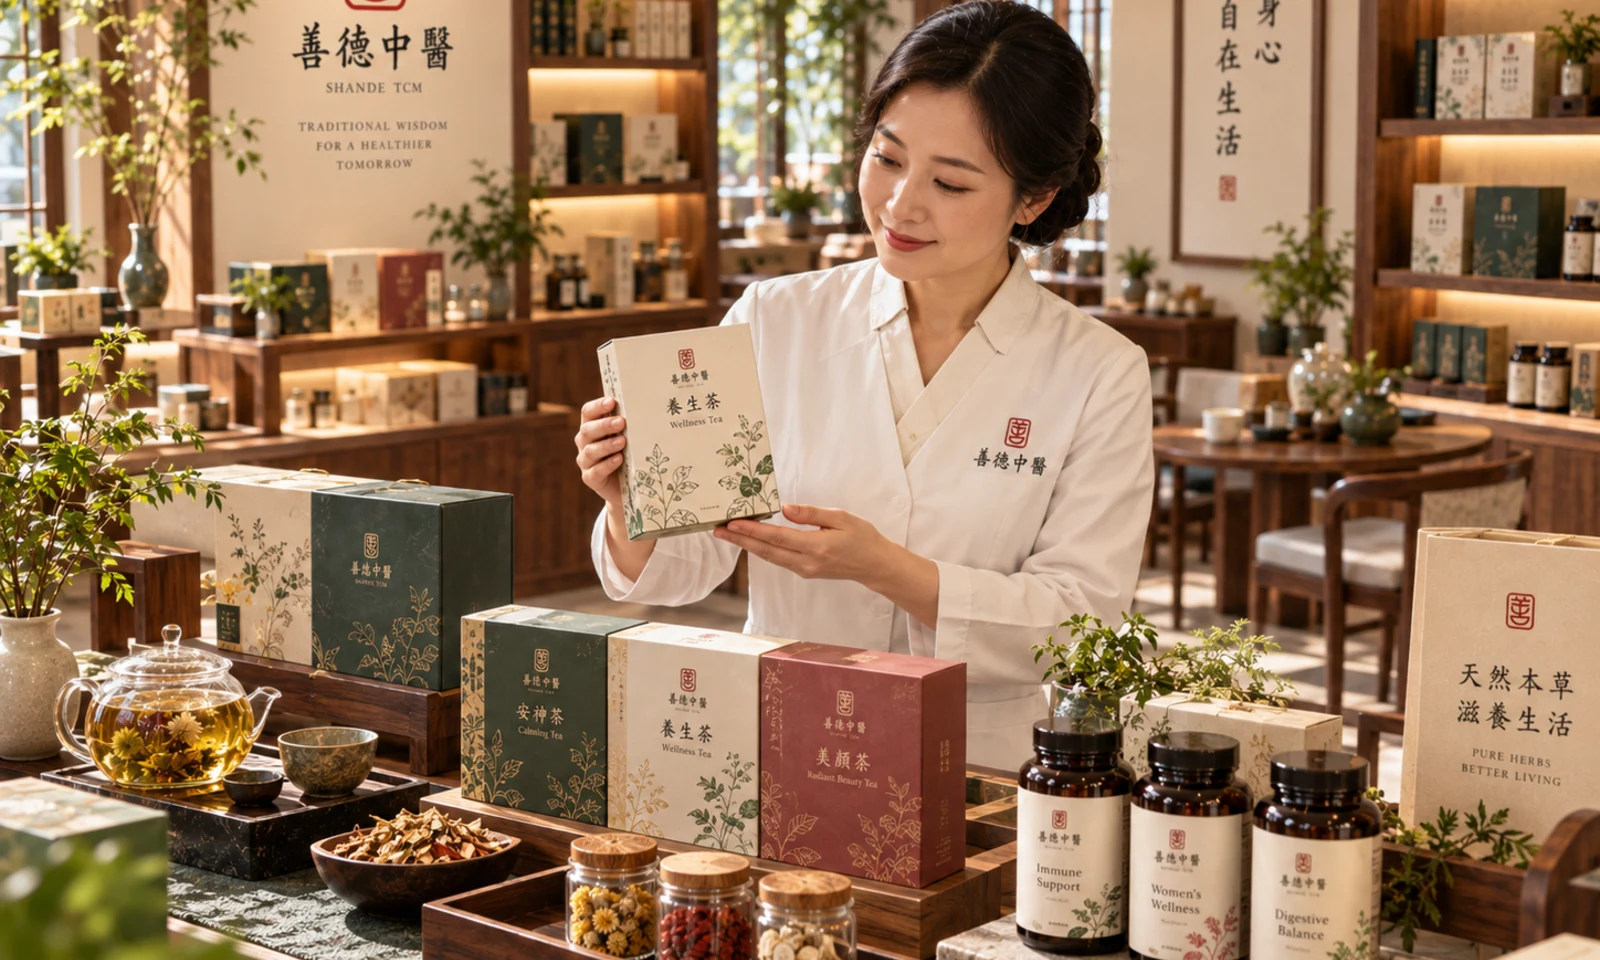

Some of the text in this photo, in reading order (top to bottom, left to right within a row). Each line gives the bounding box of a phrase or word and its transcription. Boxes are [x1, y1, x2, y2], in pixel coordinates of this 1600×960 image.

[1255, 0, 1282, 64] 身心
[292, 21, 454, 71] 善德中醫
[1216, 0, 1241, 156] 自在生活
[325, 82, 423, 94] SHANDE TCM
[298, 121, 448, 132] TRADITIONAL WISDOM
[316, 140, 432, 151] FOR A HEALTHIER
[336, 158, 413, 170] TOMORROW
[666, 392, 720, 416] 養生茶
[670, 415, 723, 429] Wellness Tea
[974, 447, 1047, 476] 善德中醫
[1459, 663, 1574, 700] 天然本草
[516, 702, 564, 725] 安神茶
[1457, 700, 1573, 737] 滋養生活
[517, 726, 563, 740] Calming Tea
[660, 718, 712, 743] 養生茶
[662, 743, 712, 758] Wellness Tea
[1472, 748, 1551, 768] PURE HERBS
[807, 770, 878, 788] Radiant Beauty Tea
[1461, 763, 1561, 786] BETTER LIVING
[1037, 863, 1082, 878] Immune
[1037, 877, 1081, 892] Support
[1151, 883, 1202, 900] Women's
[1151, 898, 1200, 915] Wellness
[1275, 908, 1329, 926] Digestive
[1278, 924, 1324, 941] Balance
